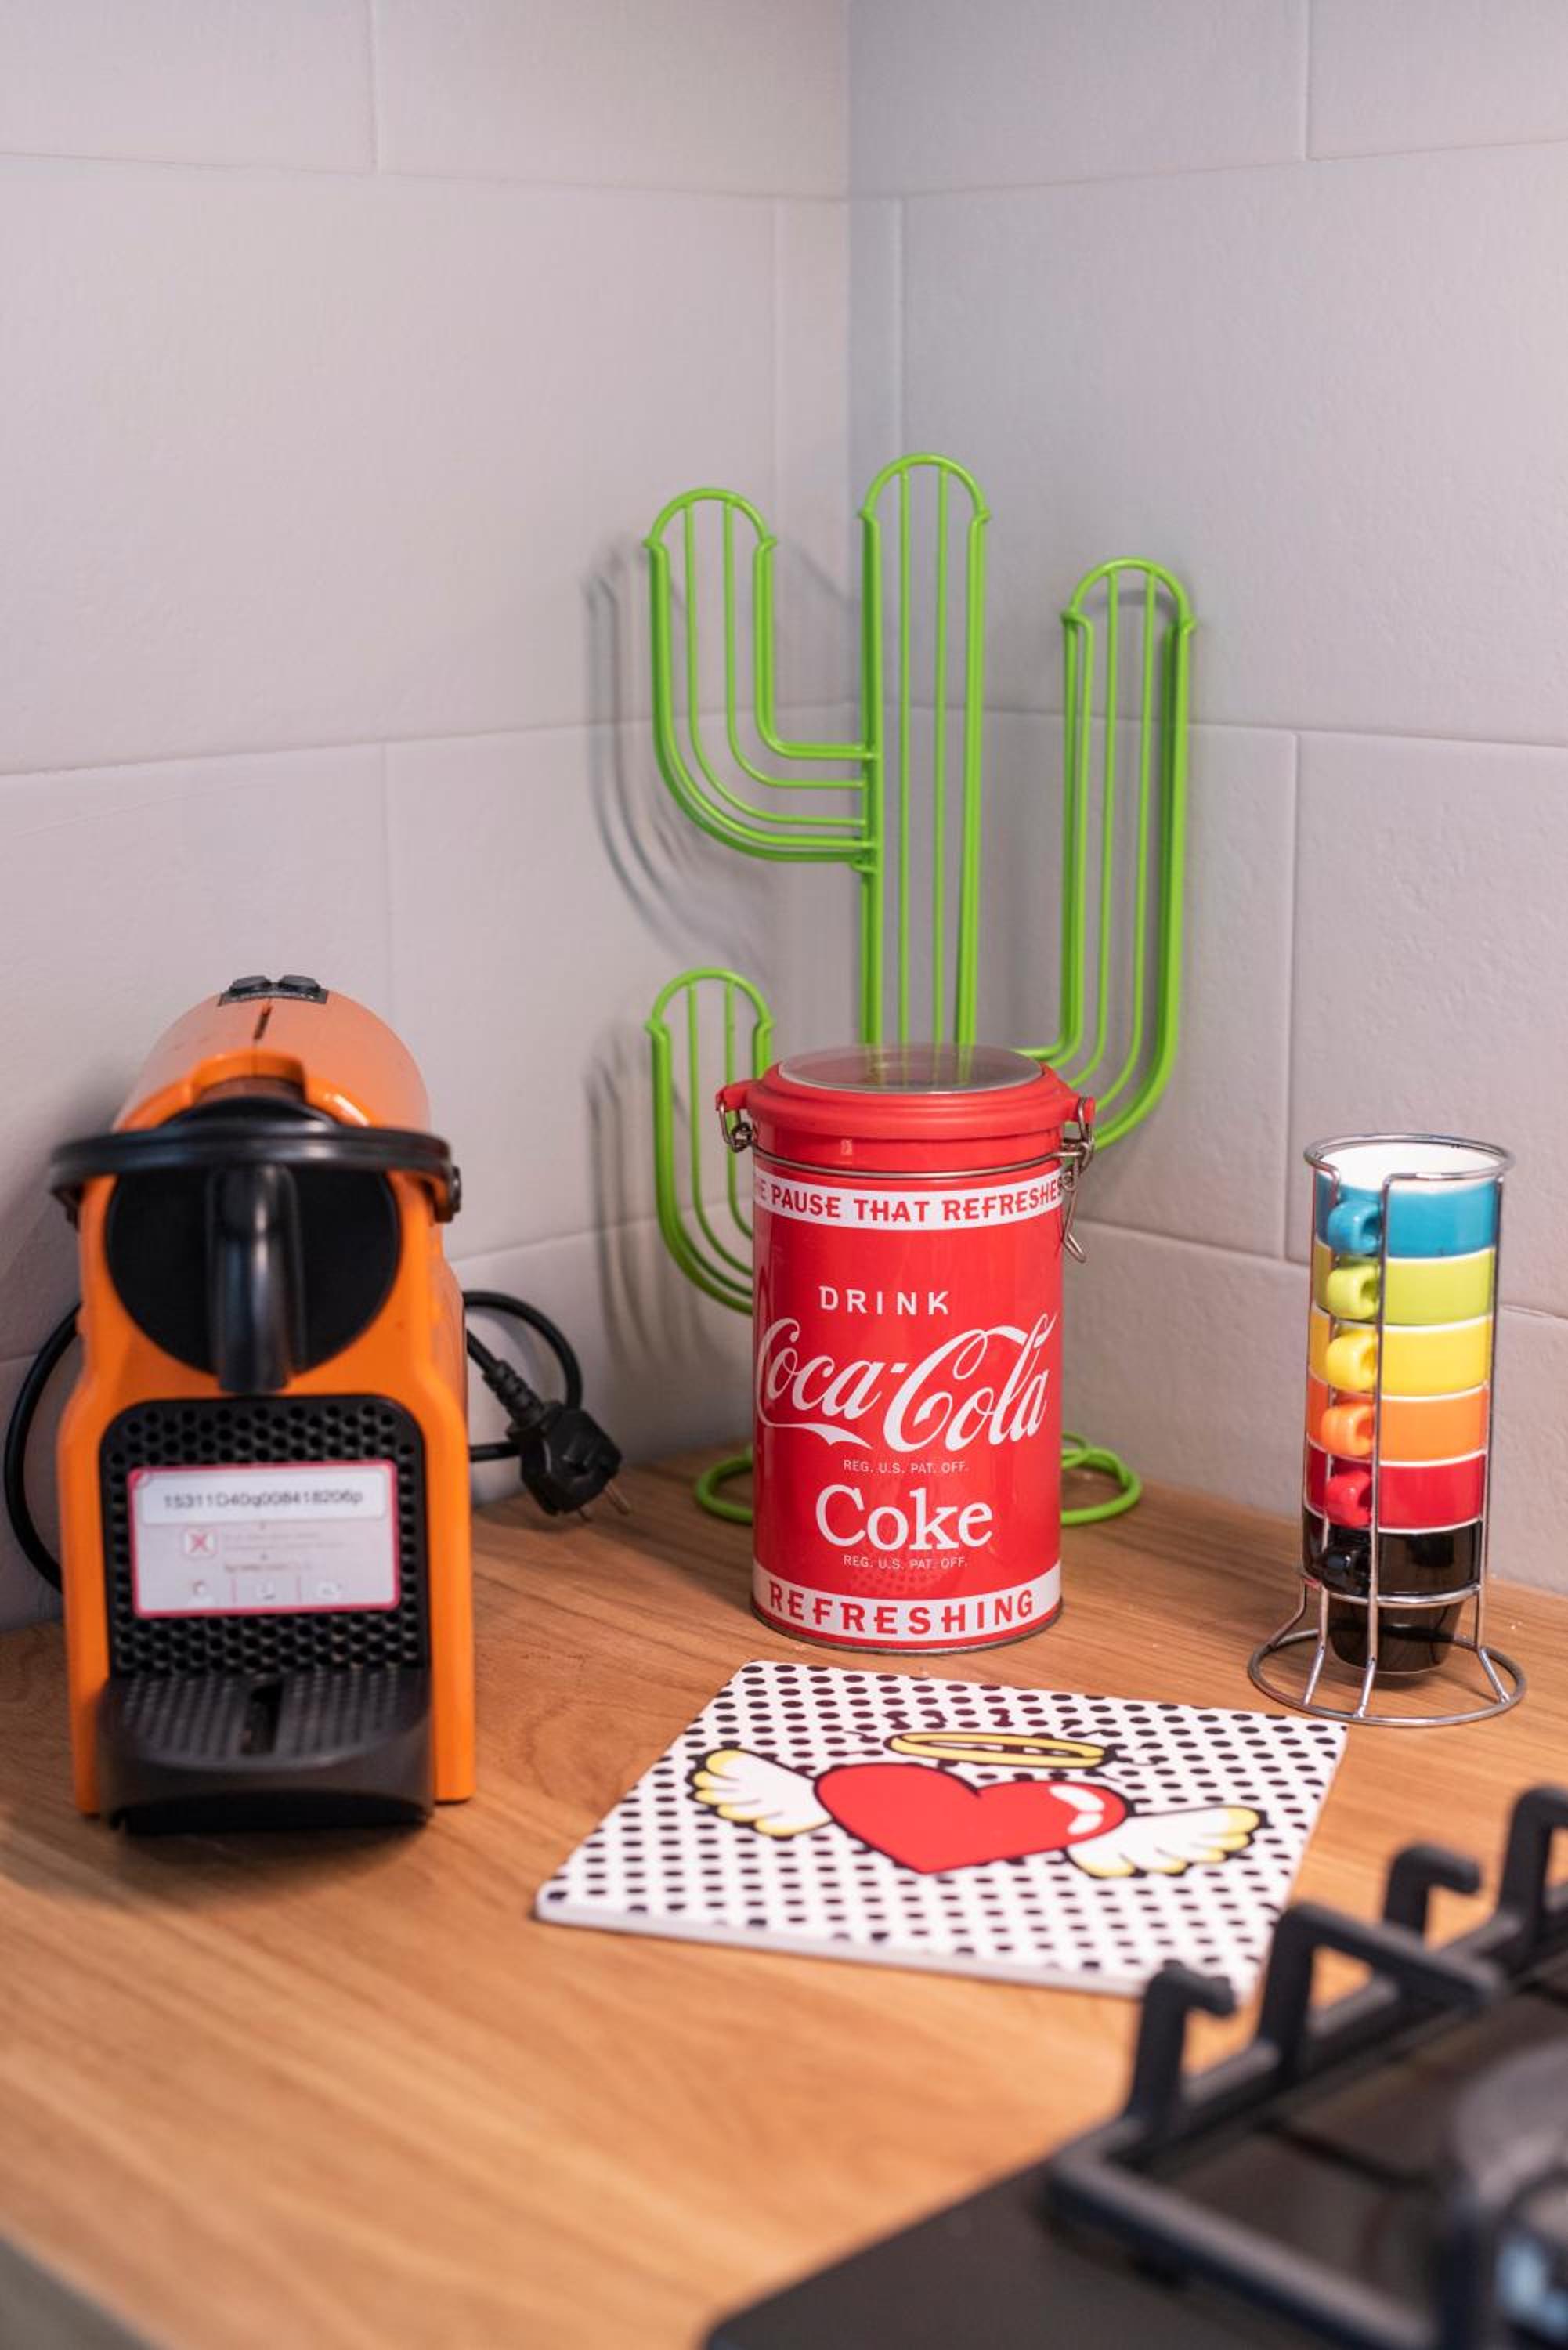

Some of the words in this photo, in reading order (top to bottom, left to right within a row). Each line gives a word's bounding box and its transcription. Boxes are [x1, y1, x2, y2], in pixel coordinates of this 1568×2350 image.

[771, 1184, 841, 1218] PAUSE
[854, 1198, 930, 1223] THAT
[818, 1285, 950, 1315] DRINK
[757, 1311, 1057, 1453] Coca-Cola
[843, 1459, 874, 1473] REG.
[878, 1462, 905, 1473] U.S.
[910, 1462, 937, 1473] PAT.
[940, 1461, 969, 1473] OFF.
[815, 1484, 993, 1551] Coke
[843, 1554, 874, 1567] REG.
[877, 1557, 905, 1570] U.S.
[909, 1558, 937, 1569] PAT.
[940, 1556, 968, 1569] OFF.
[768, 1579, 1034, 1635] REFRESHING
